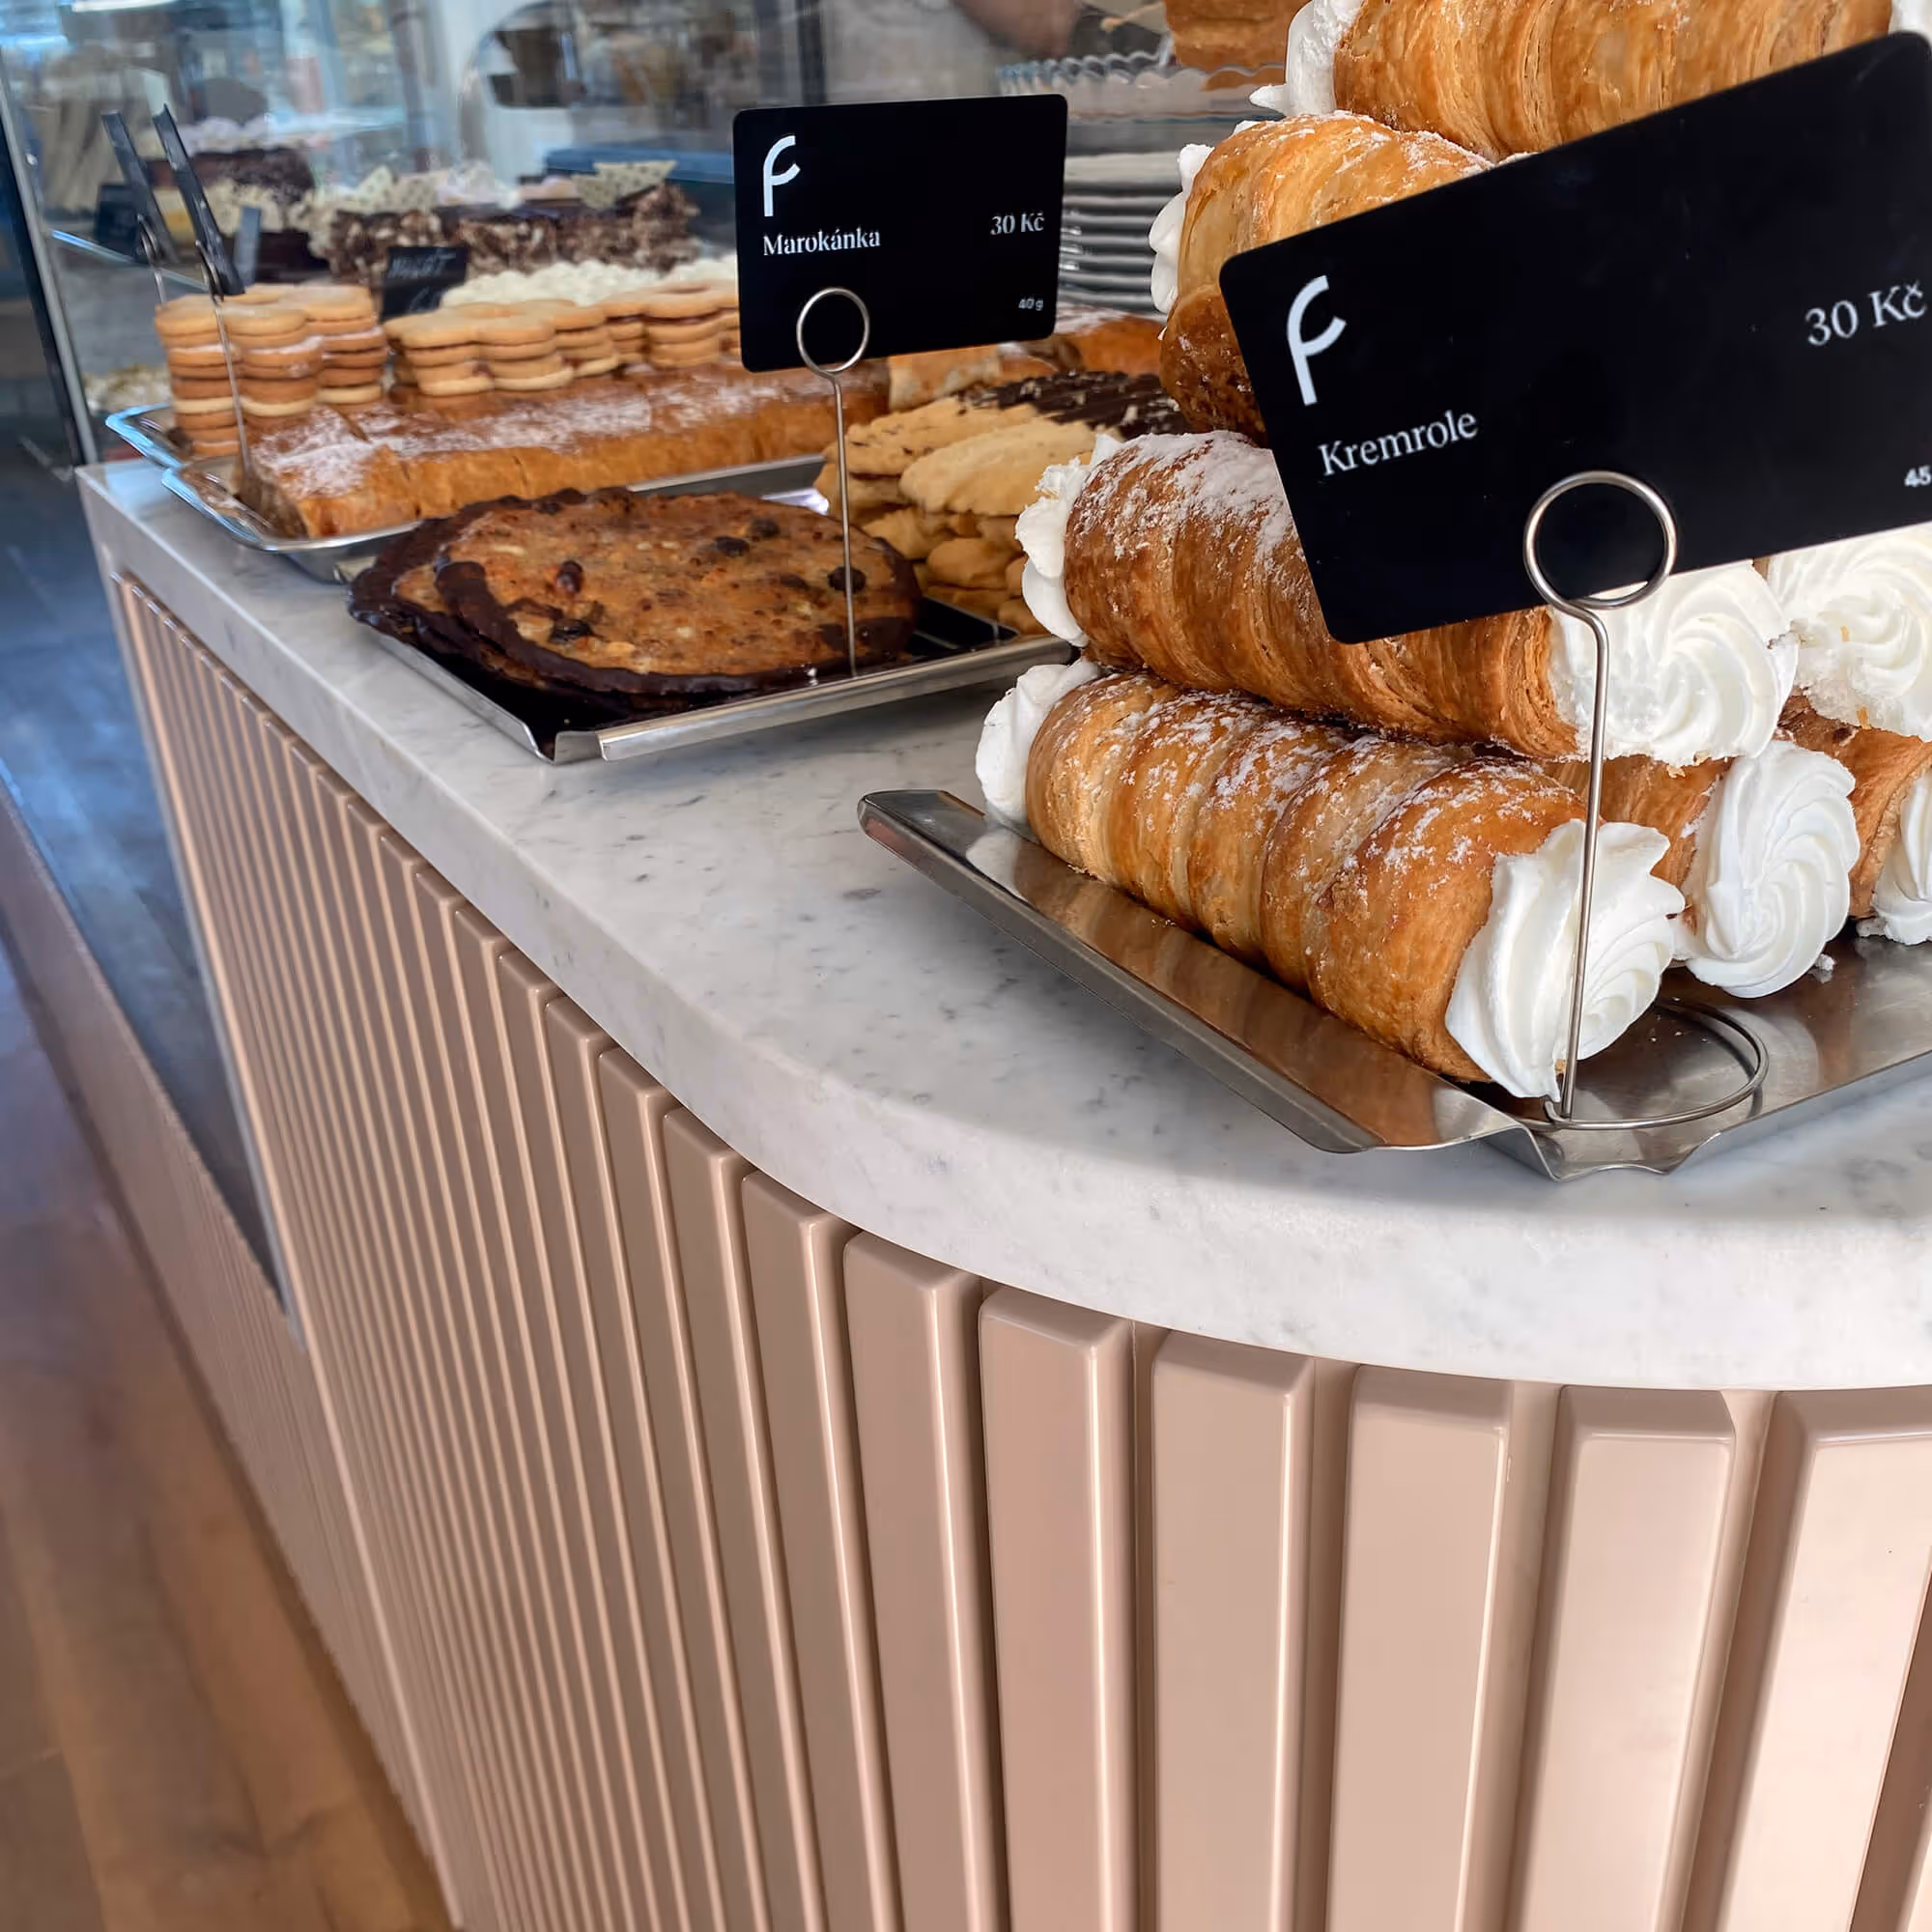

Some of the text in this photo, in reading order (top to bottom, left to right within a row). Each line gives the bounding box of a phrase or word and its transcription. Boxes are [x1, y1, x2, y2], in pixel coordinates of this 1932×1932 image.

[762, 226, 881, 256] Marokánka
[990, 212, 1045, 236] 30 Kč
[1804, 280, 1927, 346] 30 Kč
[1318, 410, 1478, 476] Kremrole
